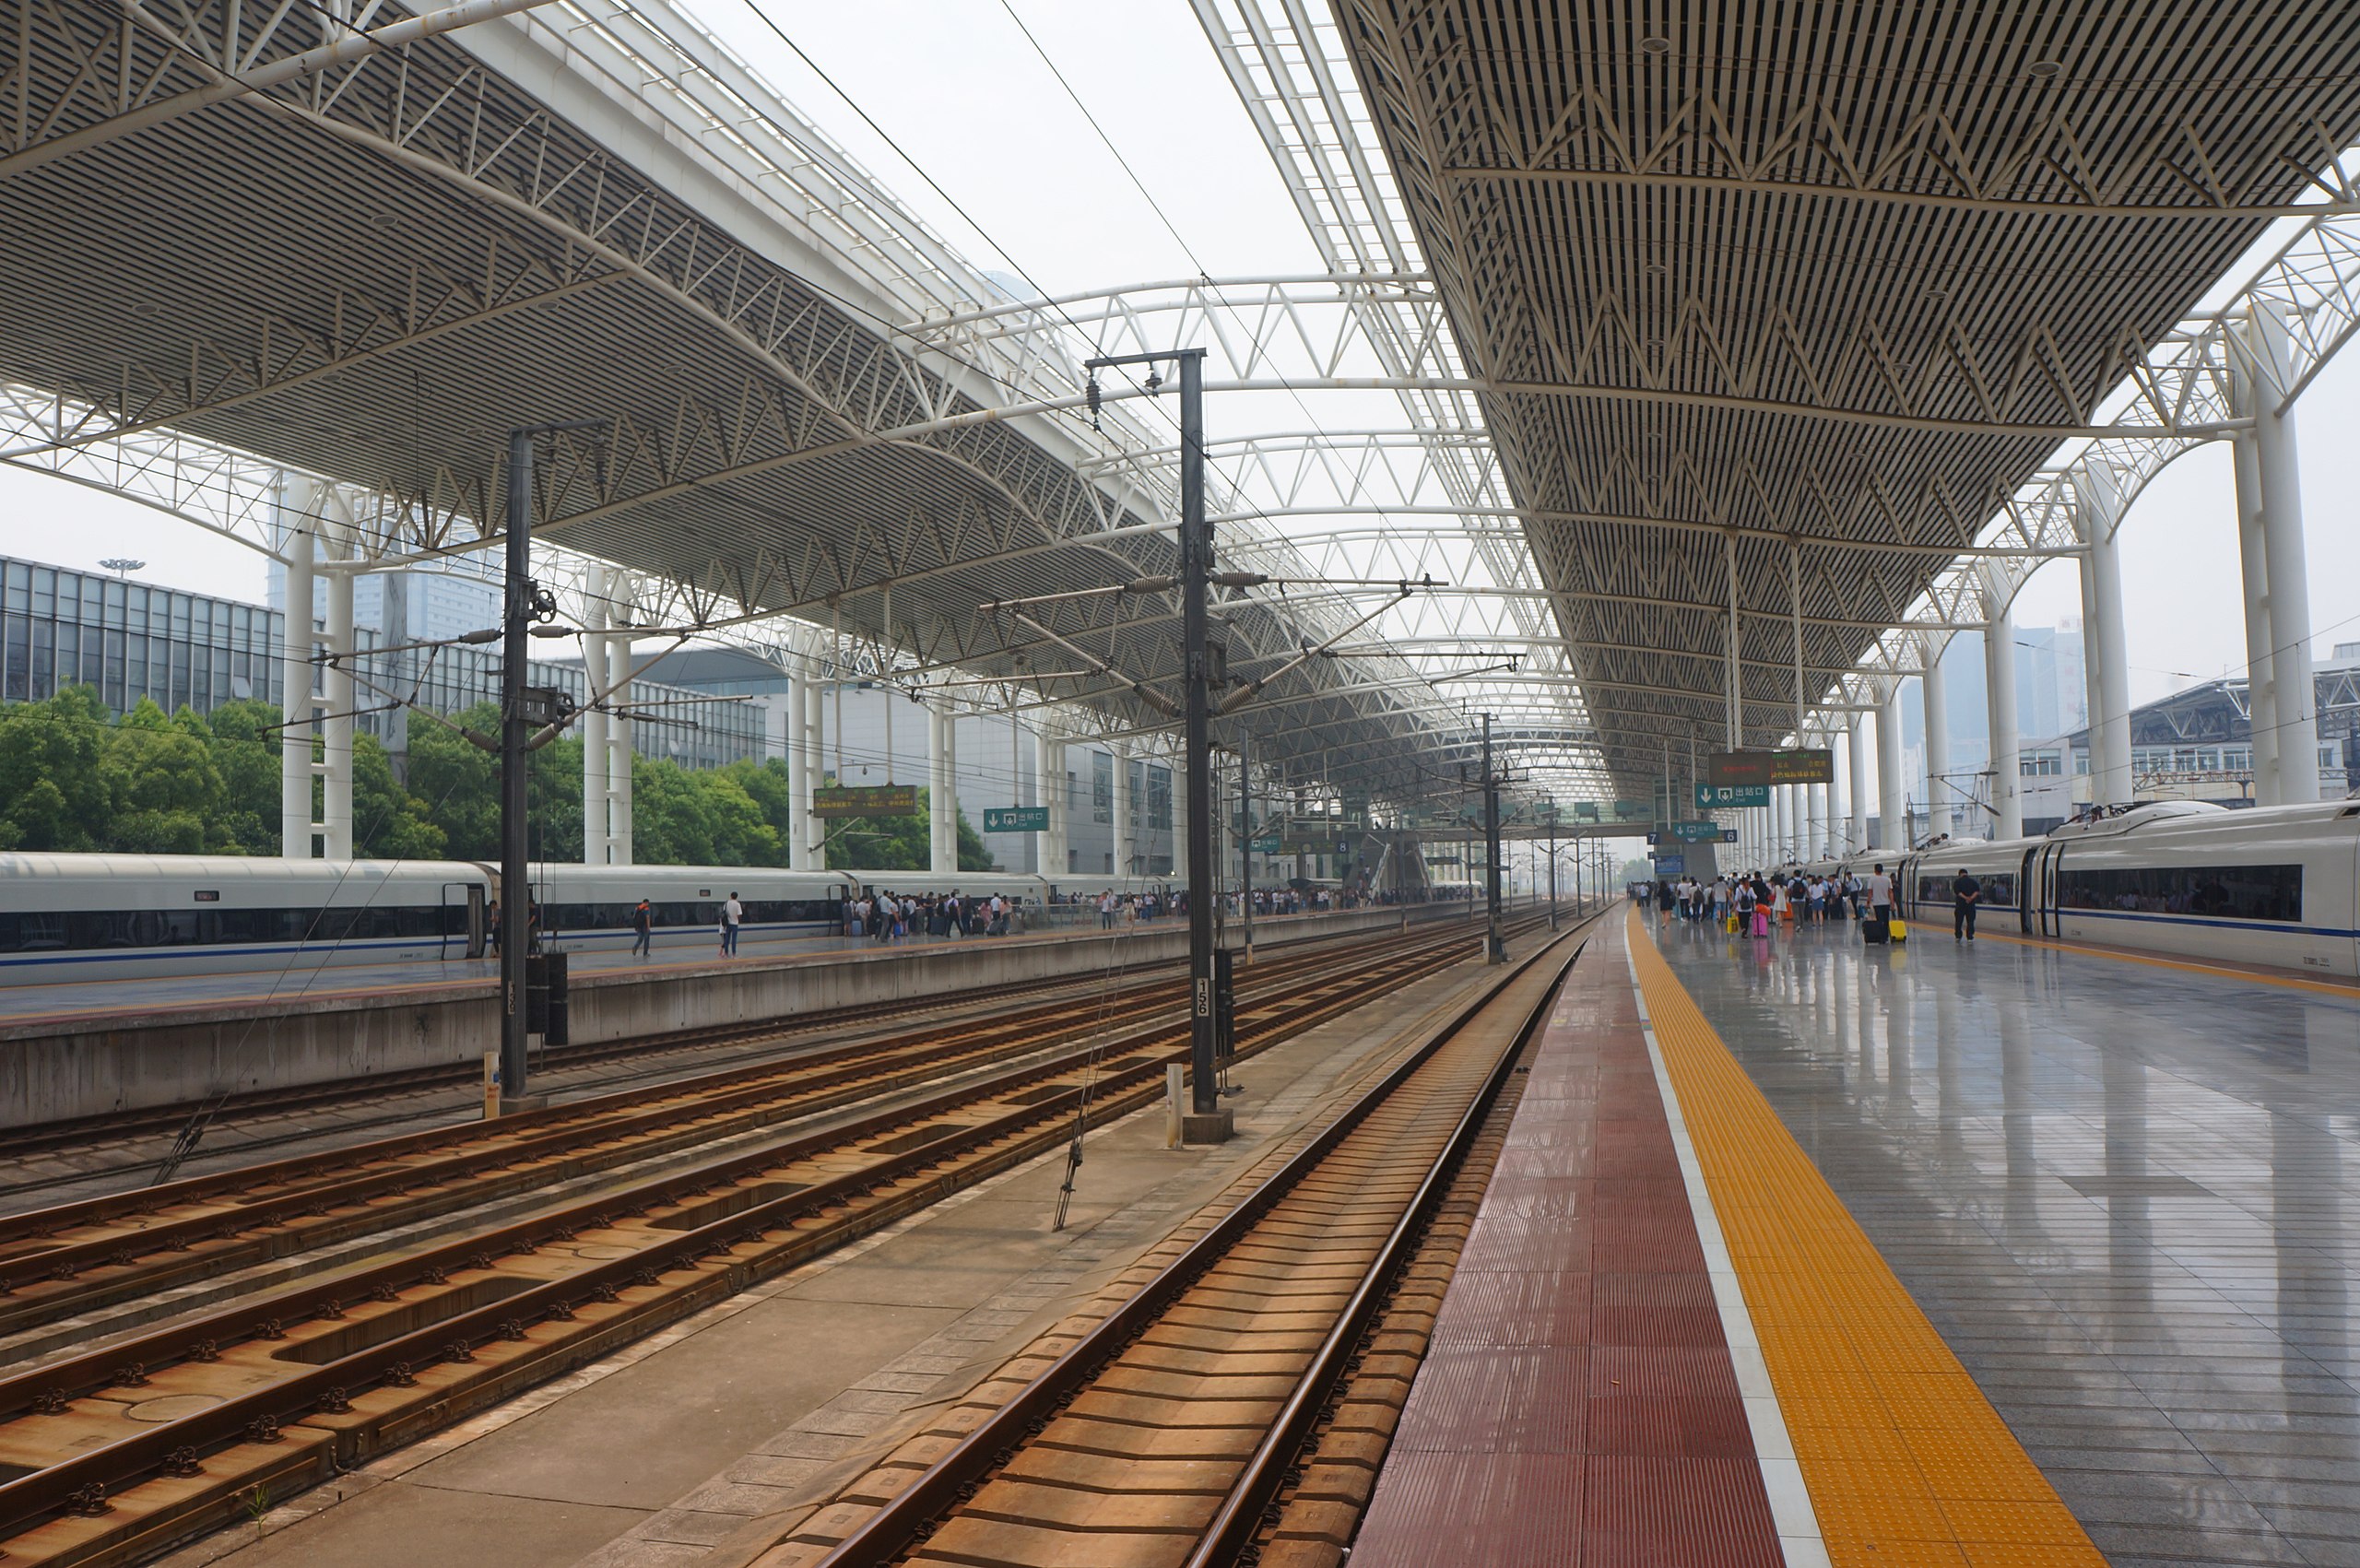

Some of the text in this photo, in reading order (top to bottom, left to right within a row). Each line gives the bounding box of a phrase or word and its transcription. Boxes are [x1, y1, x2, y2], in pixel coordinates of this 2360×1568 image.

[1735, 786, 1764, 797] 出站口
[1649, 833, 1657, 843] 7
[1727, 831, 1735, 841] 6
[1339, 843, 1346, 852] 8
